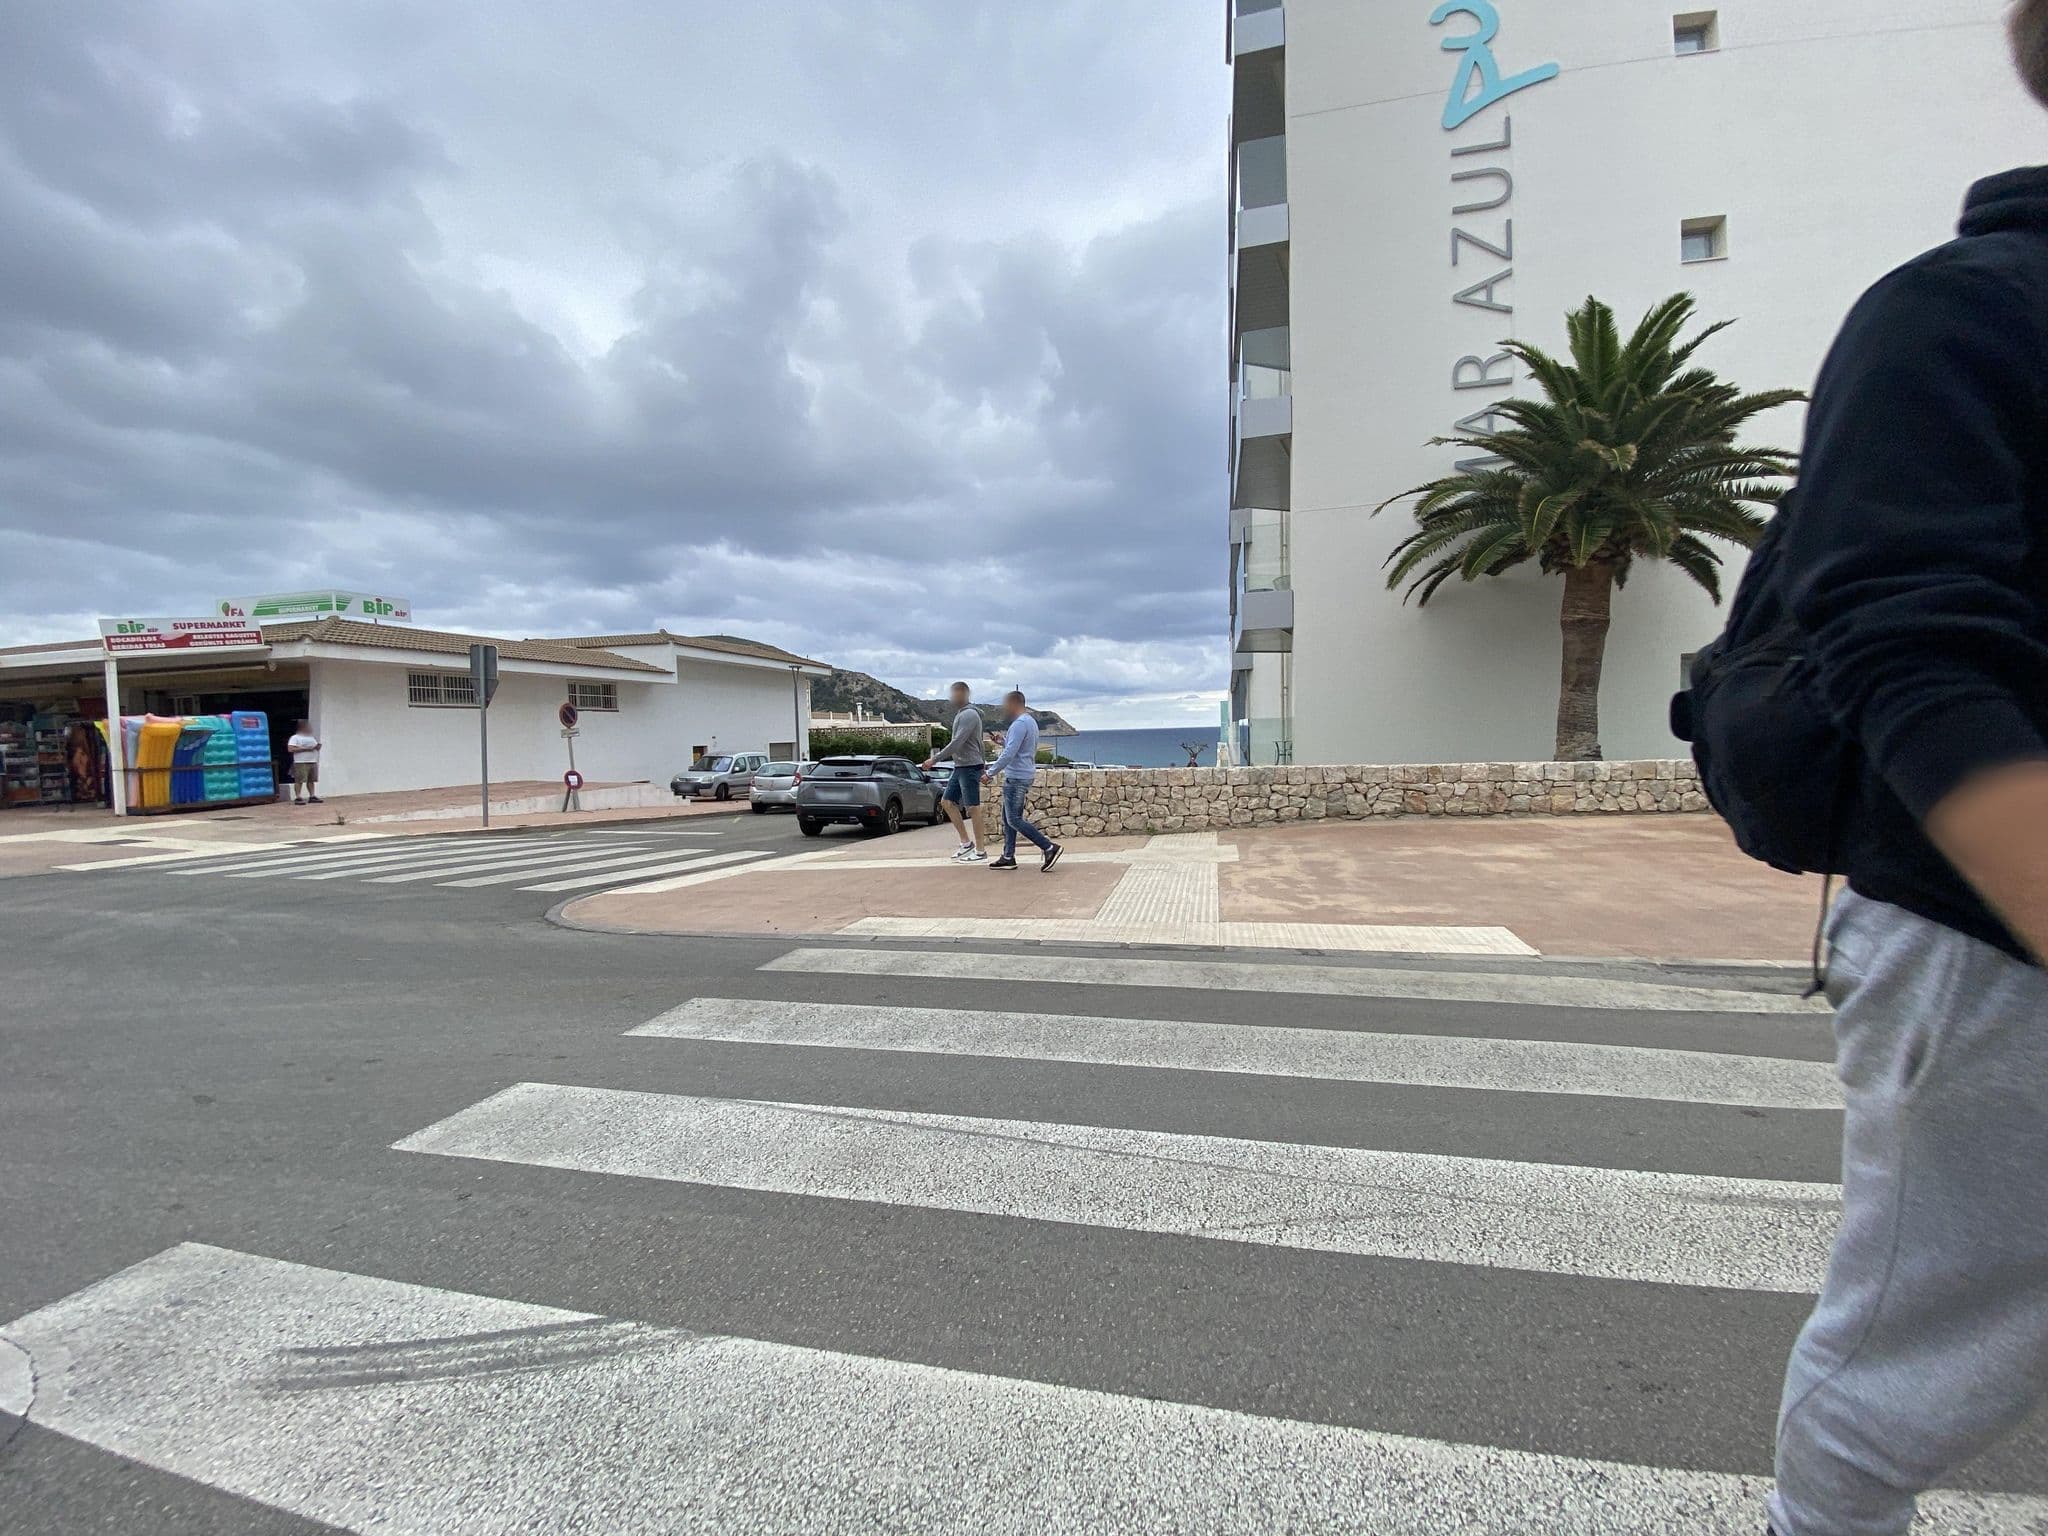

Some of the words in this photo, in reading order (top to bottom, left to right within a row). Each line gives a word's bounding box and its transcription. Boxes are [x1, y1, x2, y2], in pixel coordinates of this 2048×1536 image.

[1451, 115, 1513, 314] AZUL
[363, 598, 393, 615] BIP
[117, 621, 145, 634] BIP
[173, 621, 246, 631] SUPERMARKET
